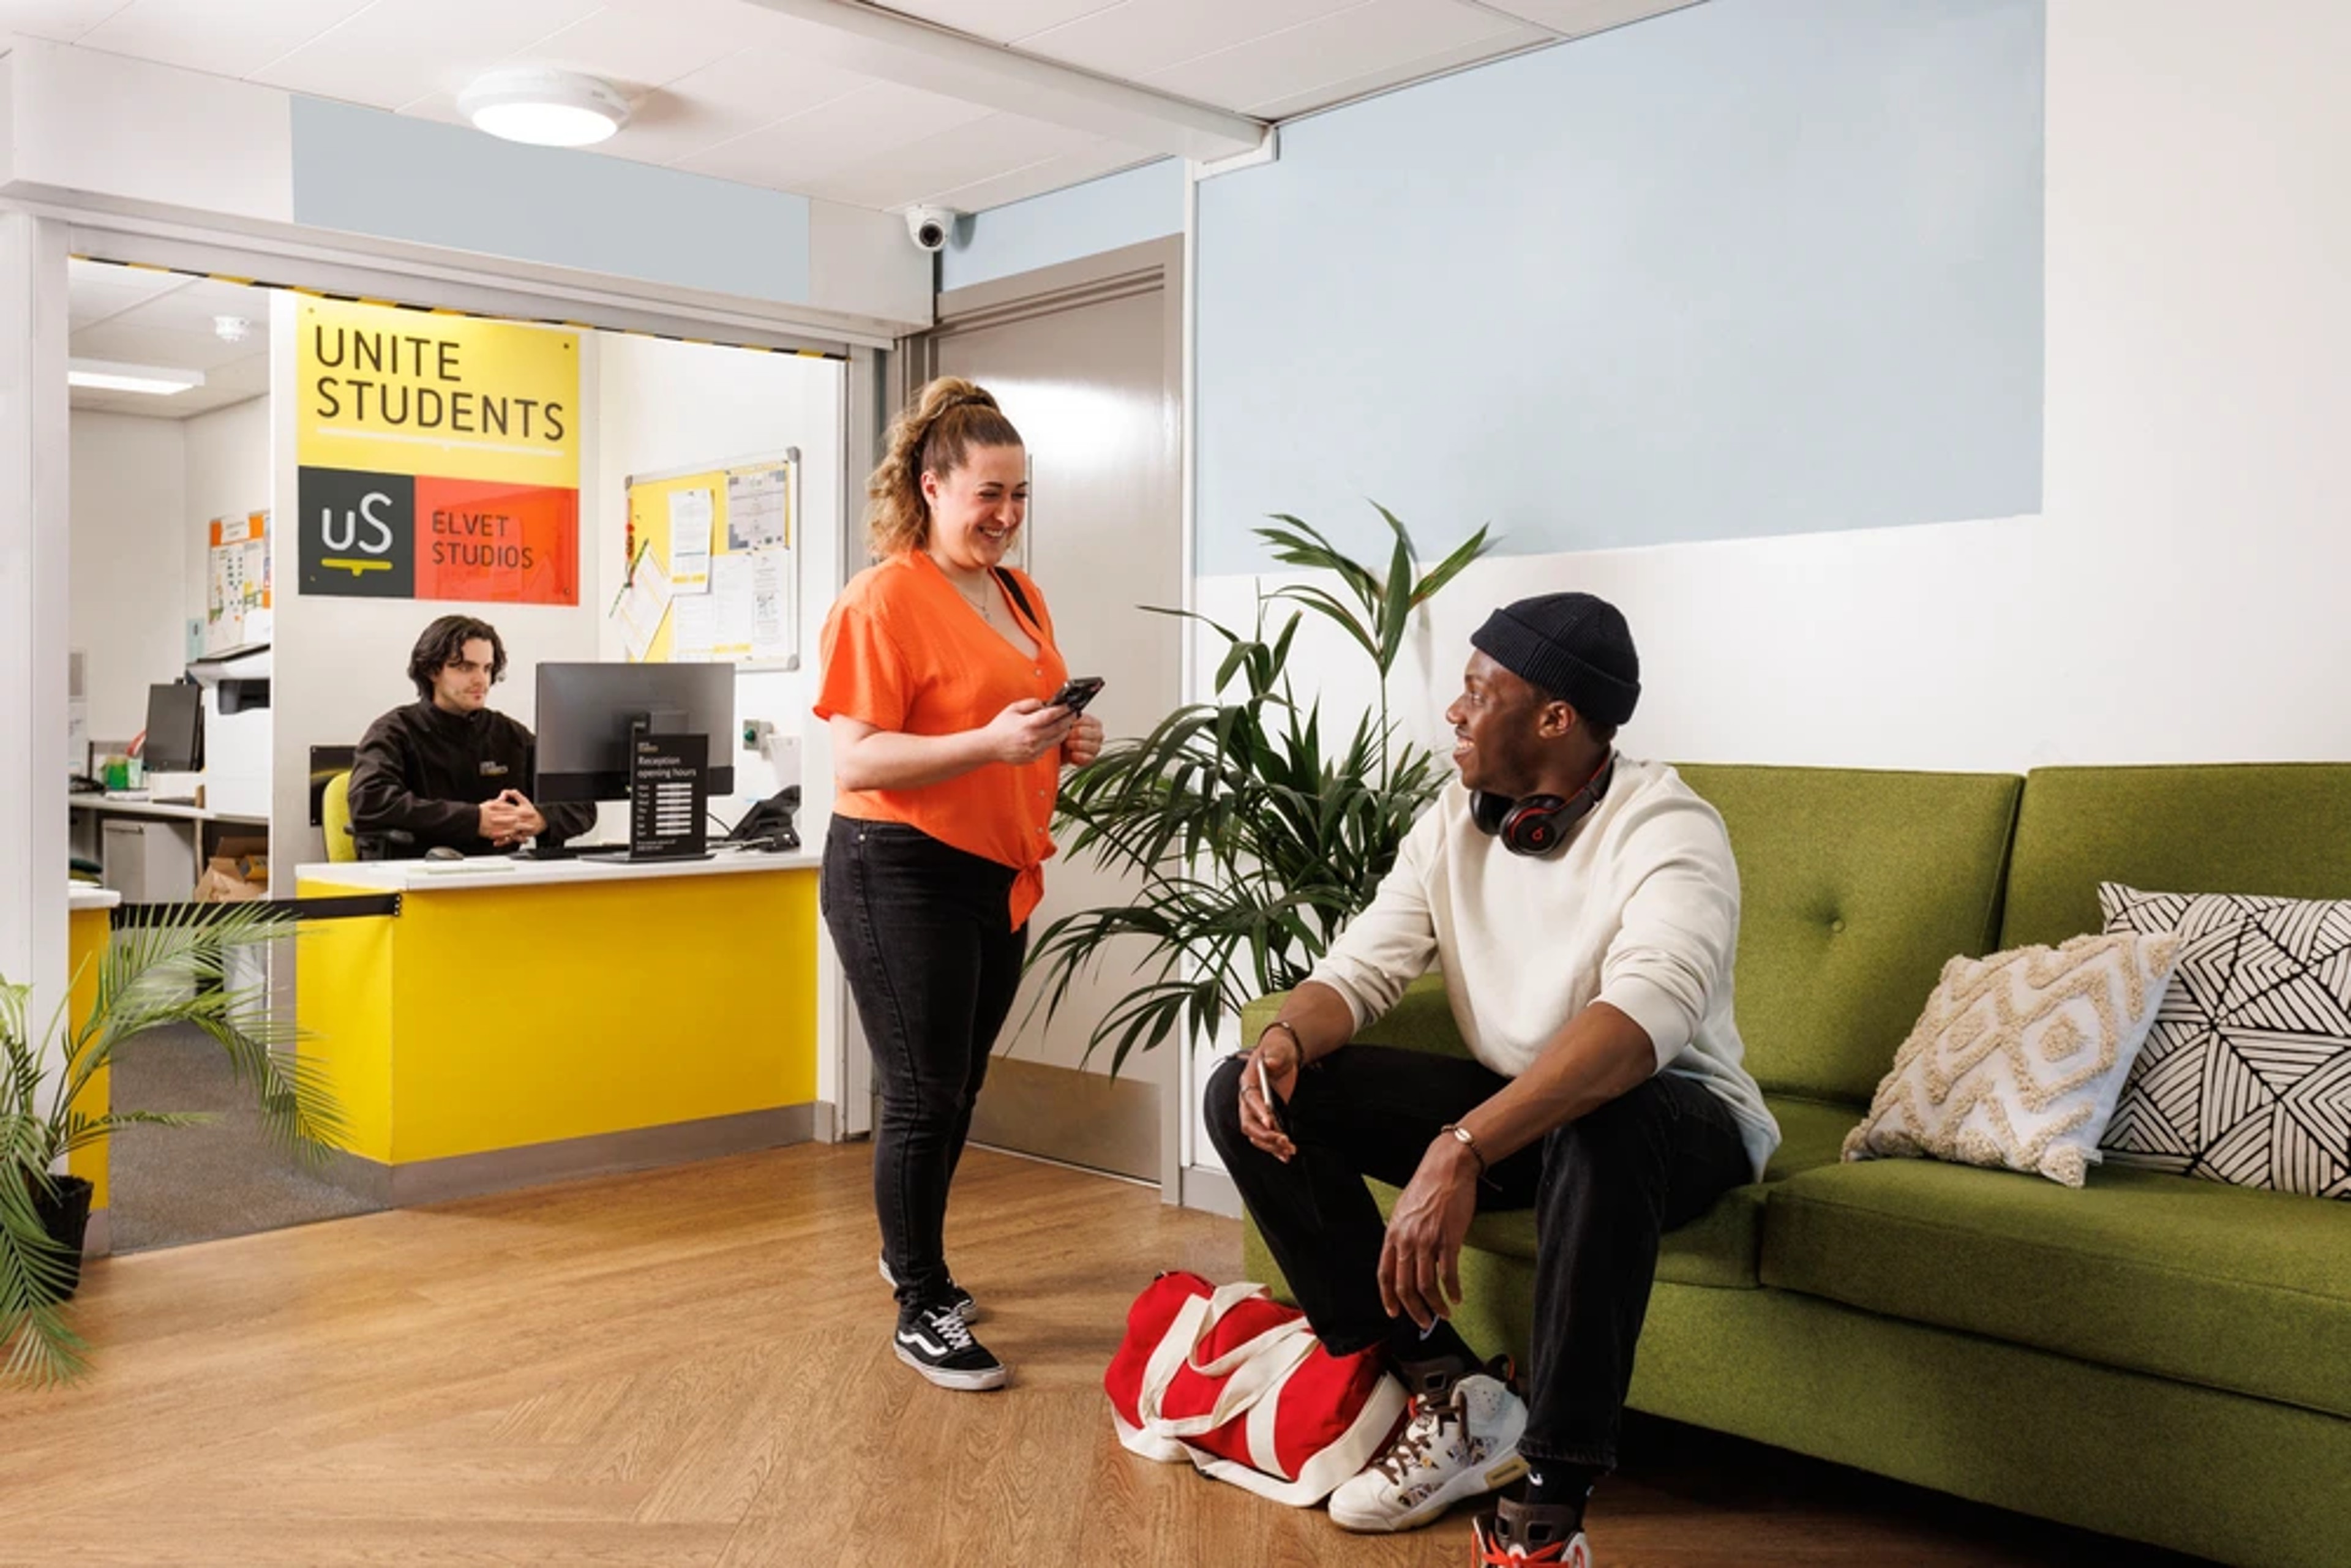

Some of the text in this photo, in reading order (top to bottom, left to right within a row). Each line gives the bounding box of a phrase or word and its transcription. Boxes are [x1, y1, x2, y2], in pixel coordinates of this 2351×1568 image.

[315, 324, 461, 381] UNITE
[317, 377, 565, 441] STUDENTS
[321, 492, 393, 554] uS
[432, 511, 509, 537] ELVET
[432, 542, 534, 569] STUDIOS
[637, 767, 697, 779] opening hours
[638, 756, 681, 767] Reception
